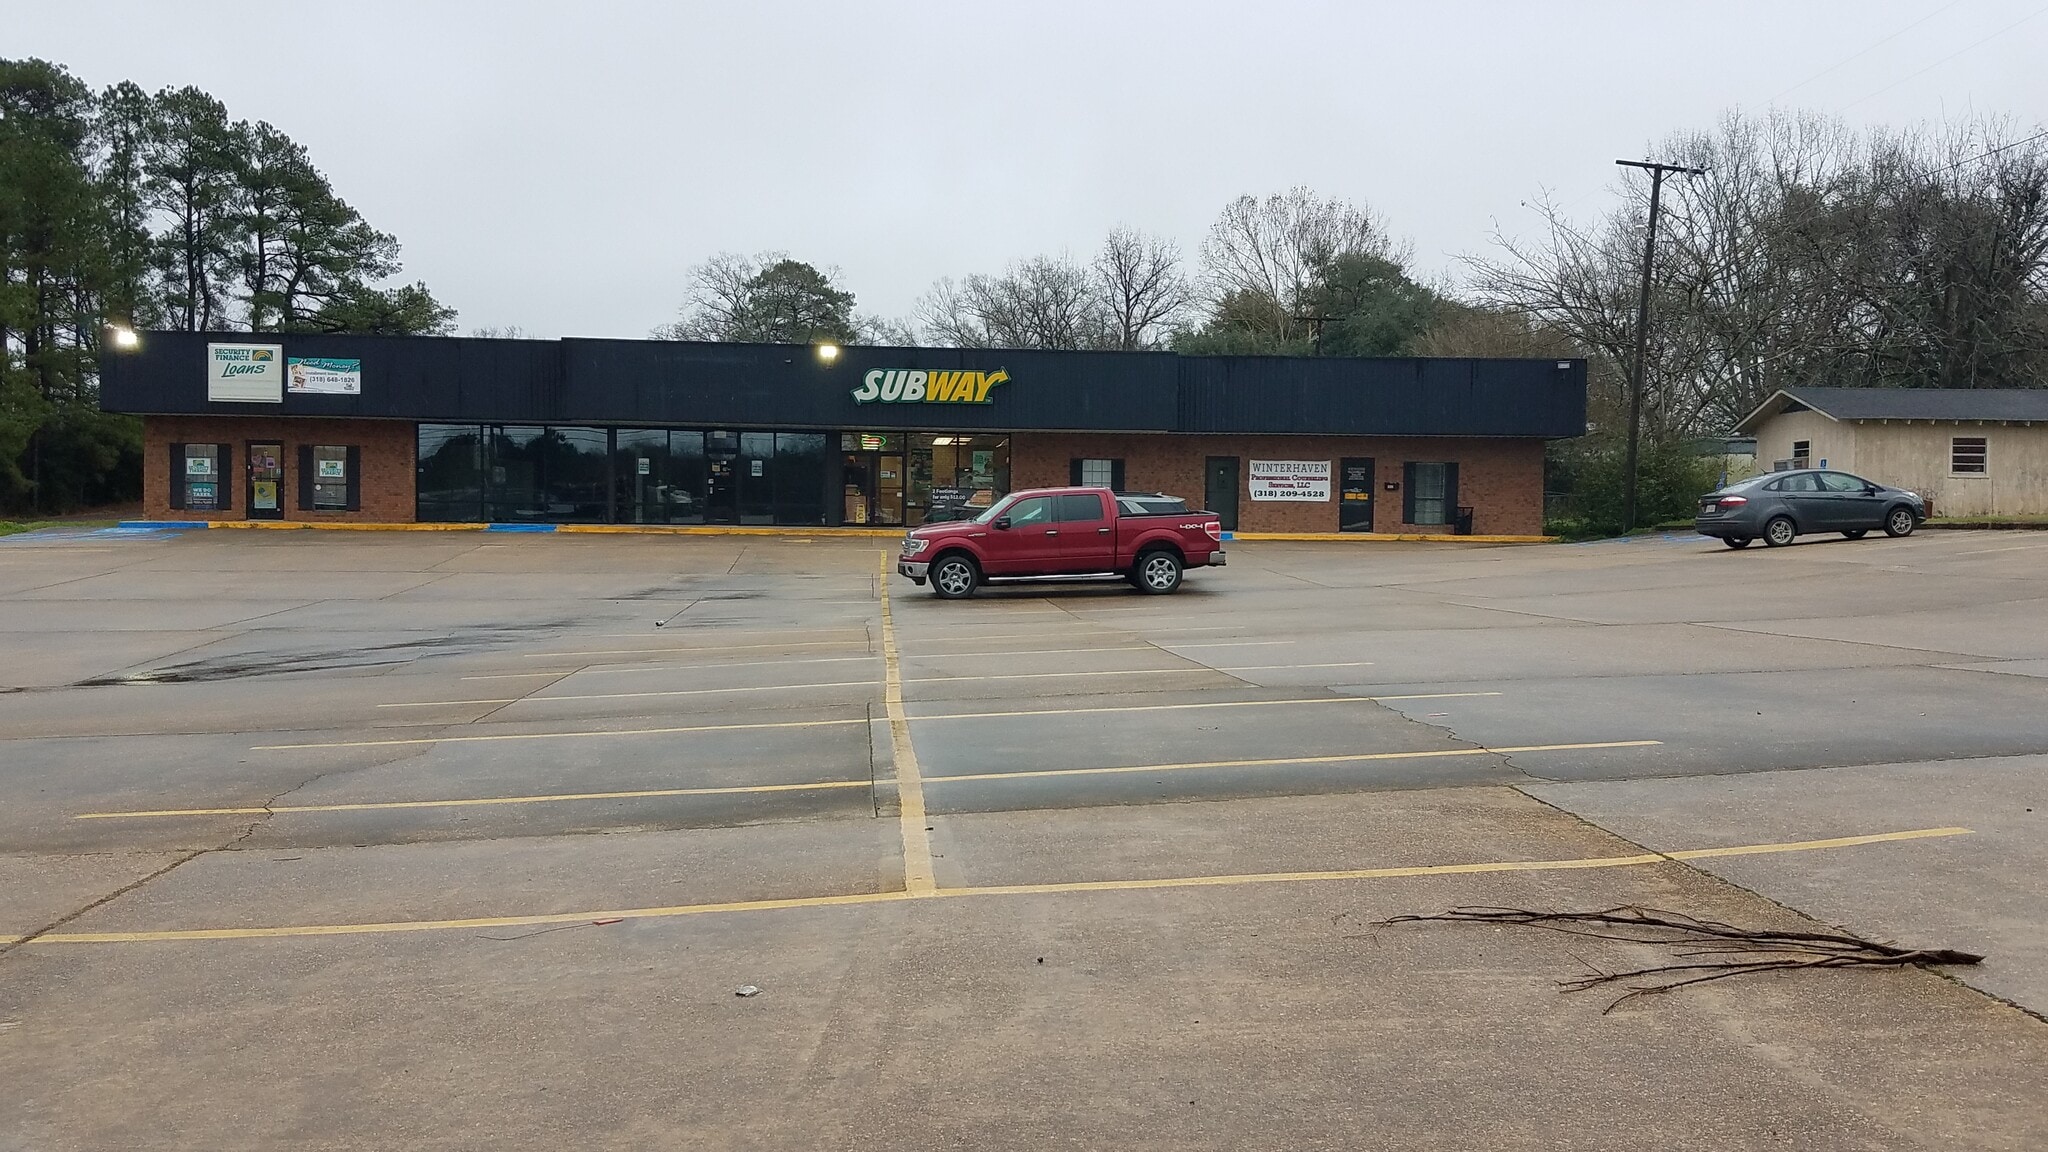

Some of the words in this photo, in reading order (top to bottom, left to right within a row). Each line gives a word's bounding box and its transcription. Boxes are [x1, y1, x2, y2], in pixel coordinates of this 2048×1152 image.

[221, 362, 266, 378] Loans
[299, 358, 321, 366] Need
[322, 360, 360, 374] Money?
[310, 376, 325, 384] (318)
[853, 369, 1008, 402] SUBWAY
[1252, 463, 1328, 473] WINTERHAVEN
[1254, 490, 1277, 498] (318)
